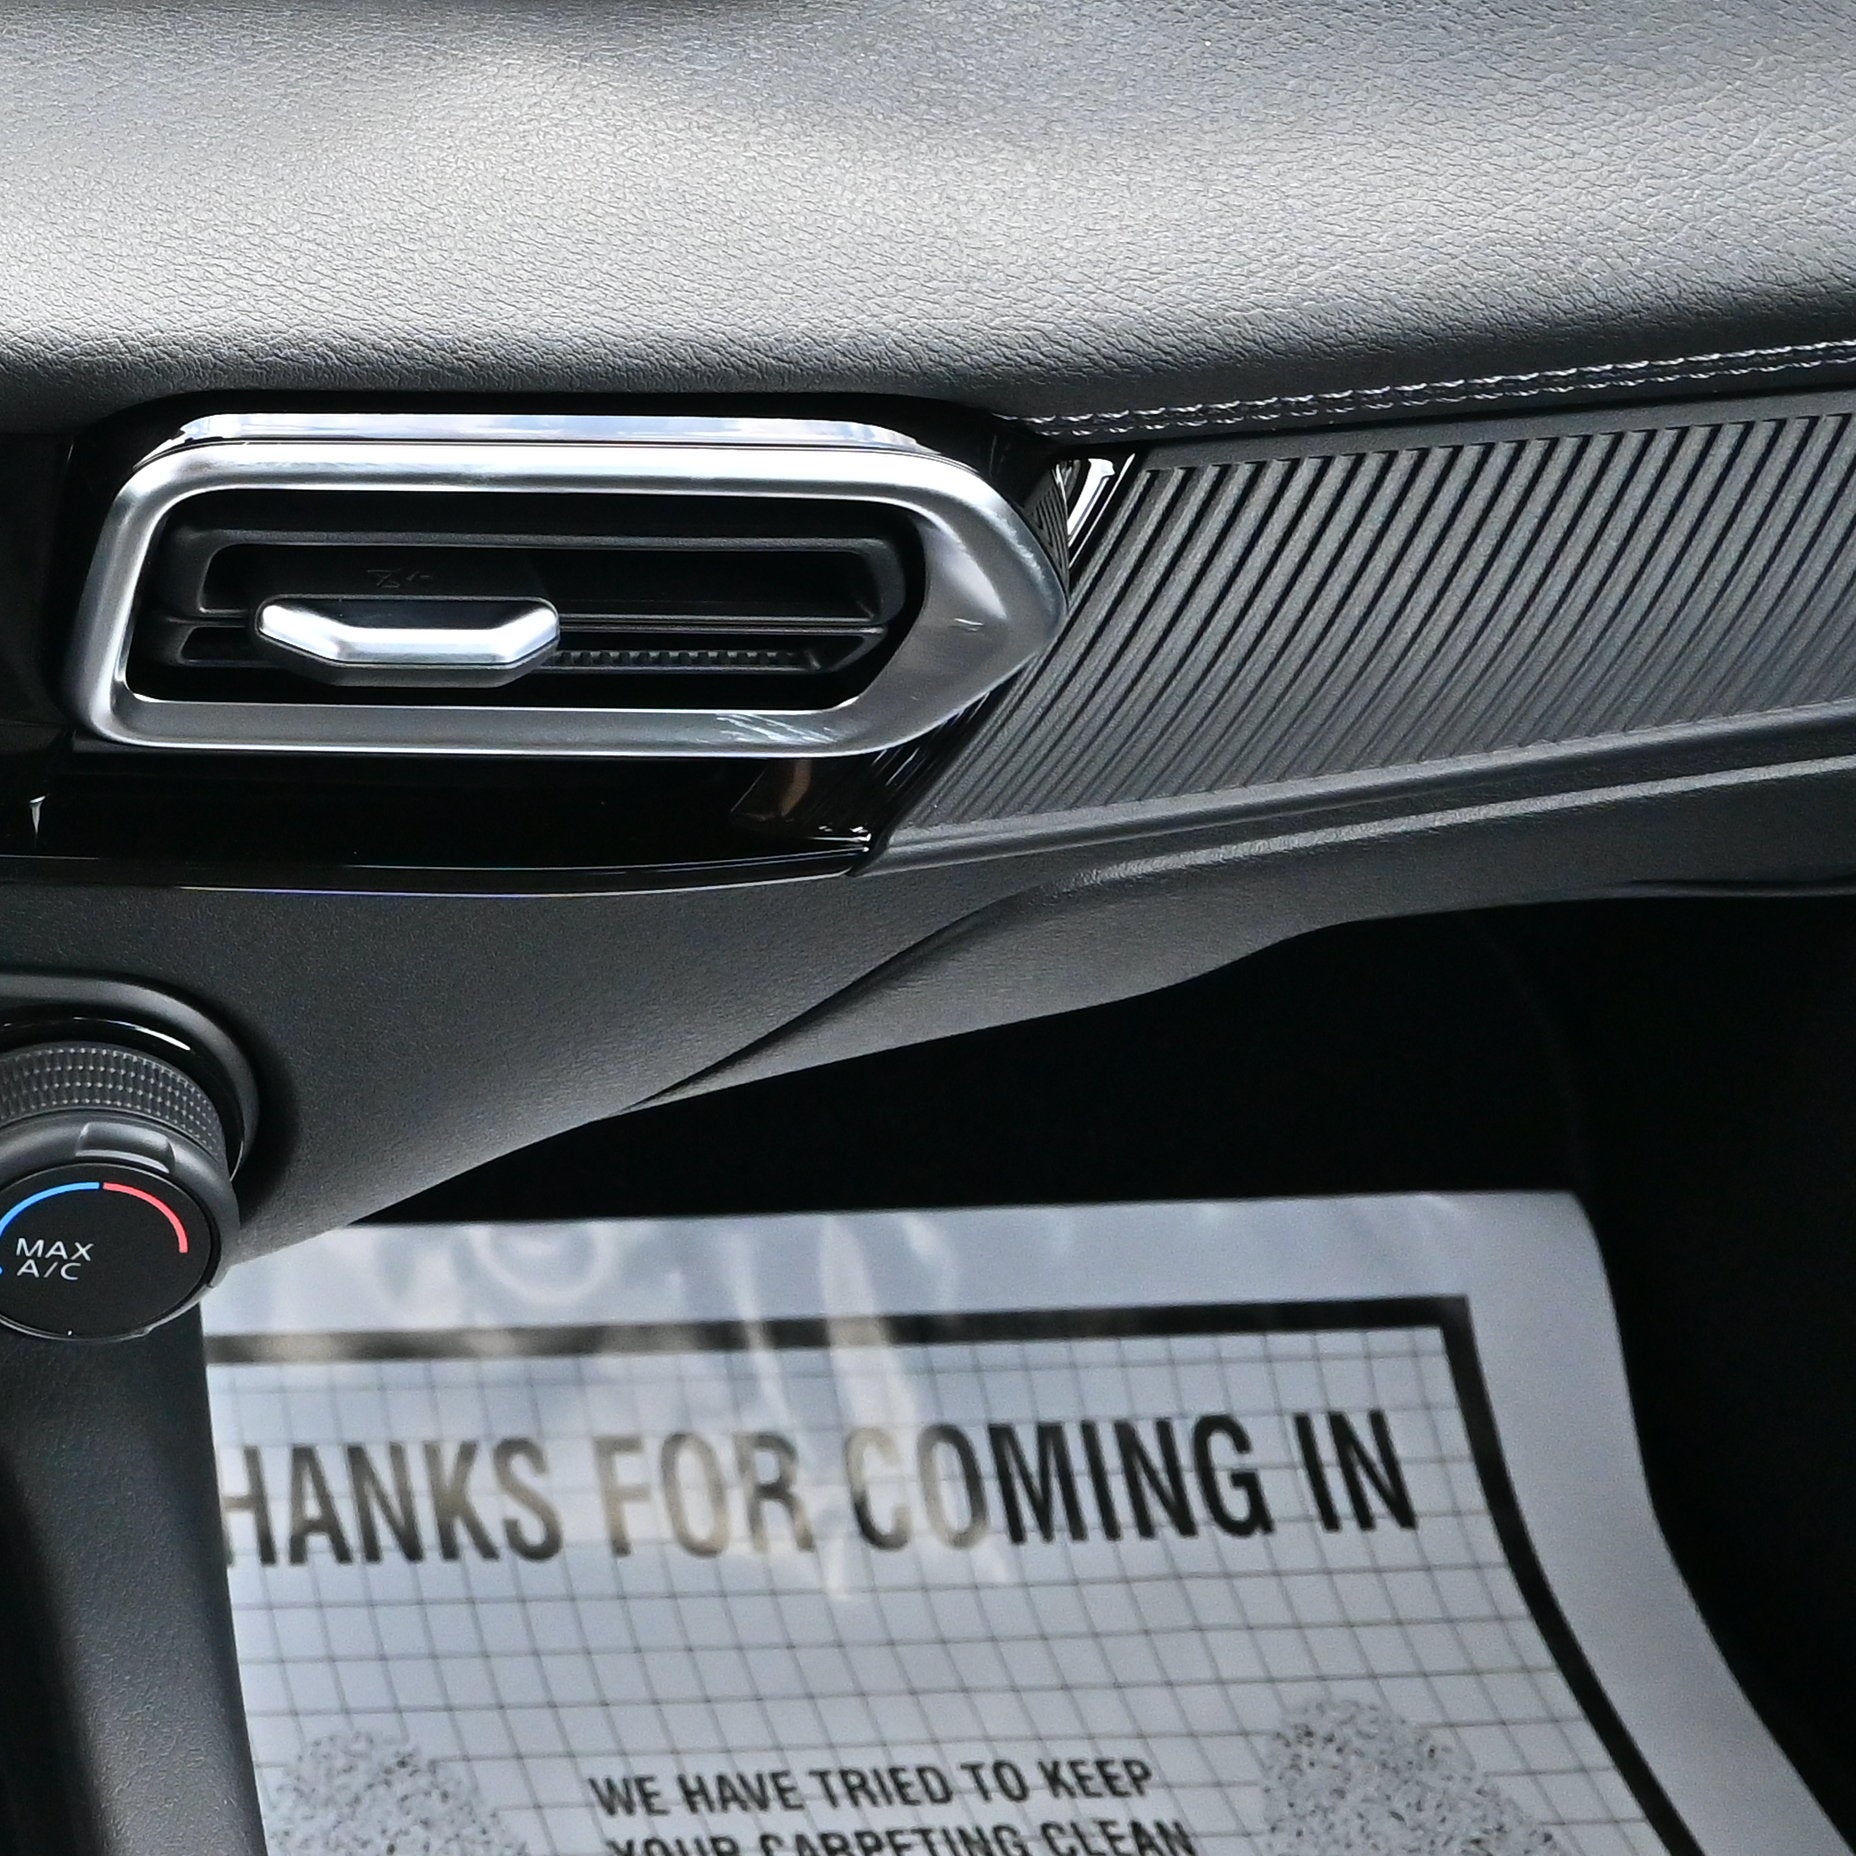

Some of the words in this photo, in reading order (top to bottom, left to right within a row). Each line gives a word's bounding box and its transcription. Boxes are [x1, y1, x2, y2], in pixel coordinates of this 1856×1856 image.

[16, 1237, 94, 1261] MAX
[17, 1259, 81, 1281] A/C
[593, 1432, 816, 1558] FOR
[842, 1414, 1273, 1551] COMING
[1292, 1409, 1420, 1533] IN
[589, 1775, 669, 1818] WE
[678, 1768, 806, 1816] HAVE
[809, 1764, 954, 1811] TRIED
[961, 1760, 1030, 1804] TO
[1038, 1757, 1154, 1800] KEEP
[1040, 1819, 1198, 1856] CLEAN
